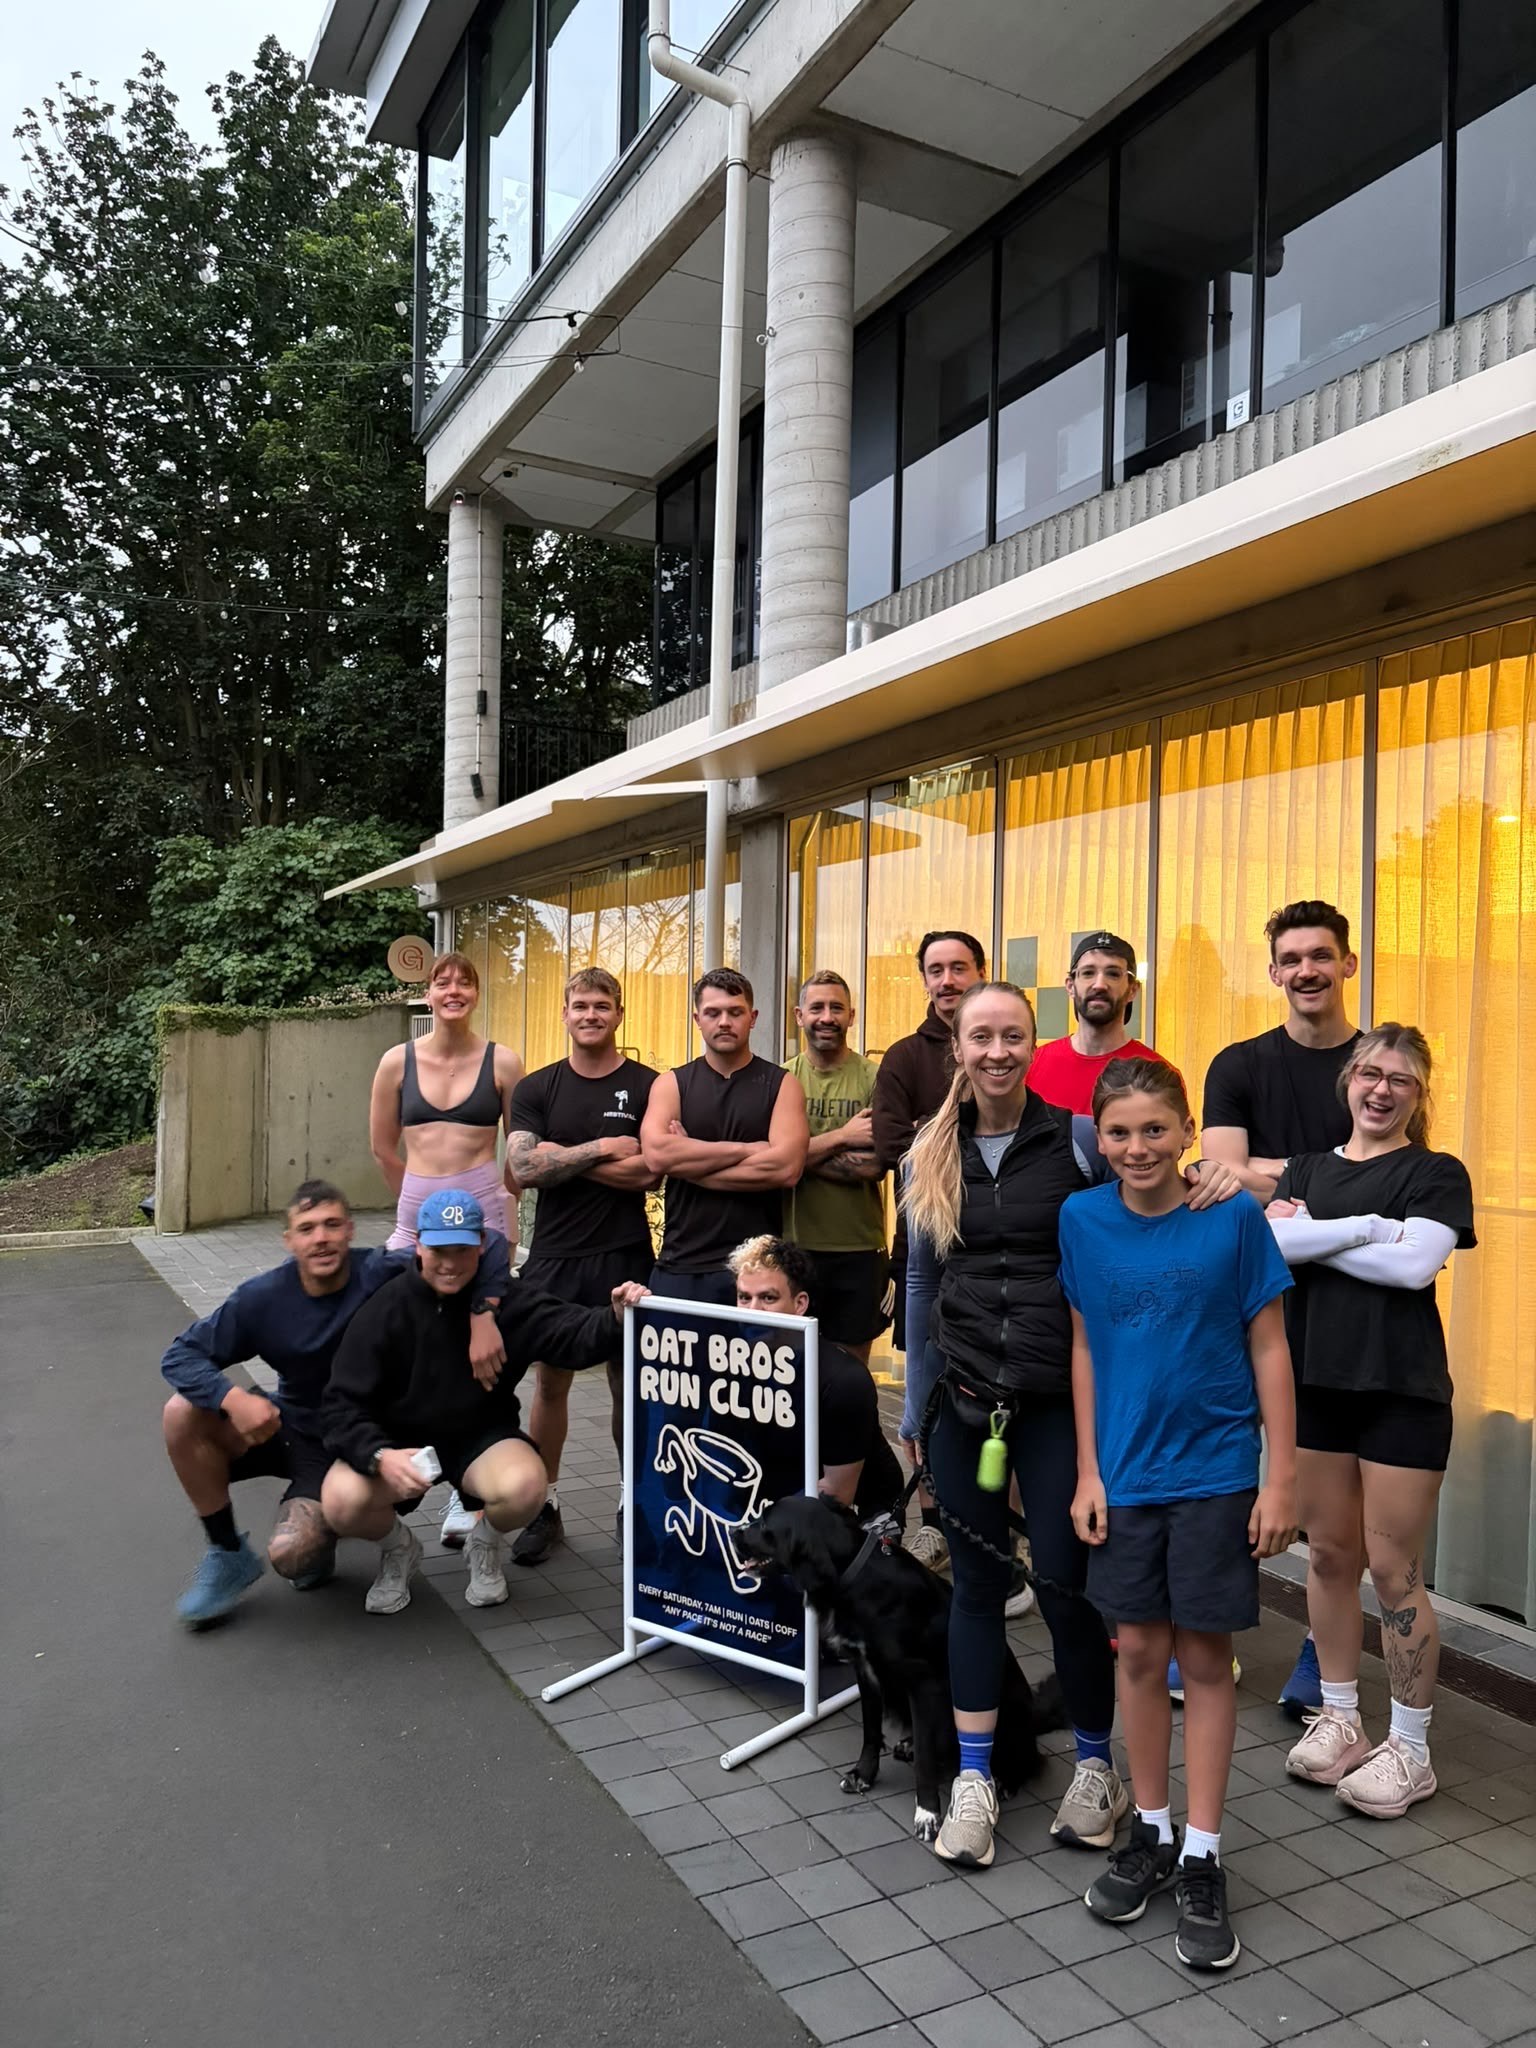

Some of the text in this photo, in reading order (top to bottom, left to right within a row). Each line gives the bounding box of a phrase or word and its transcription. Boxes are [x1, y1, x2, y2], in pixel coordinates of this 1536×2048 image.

[442, 1206, 465, 1225] OB
[640, 1324, 796, 1385] OAT BROS
[640, 1365, 796, 1428] RUN CLUB
[638, 1583, 662, 1598] EVERY
[662, 1590, 704, 1612] SATURDAY,
[704, 1602, 722, 1615] 7AM
[726, 1608, 744, 1622] RUN
[748, 1615, 770, 1630] OATS
[681, 1610, 703, 1623] PACE
[703, 1616, 719, 1628] IT'S
[719, 1621, 737, 1634] NOT
[737, 1627, 744, 1636] A
